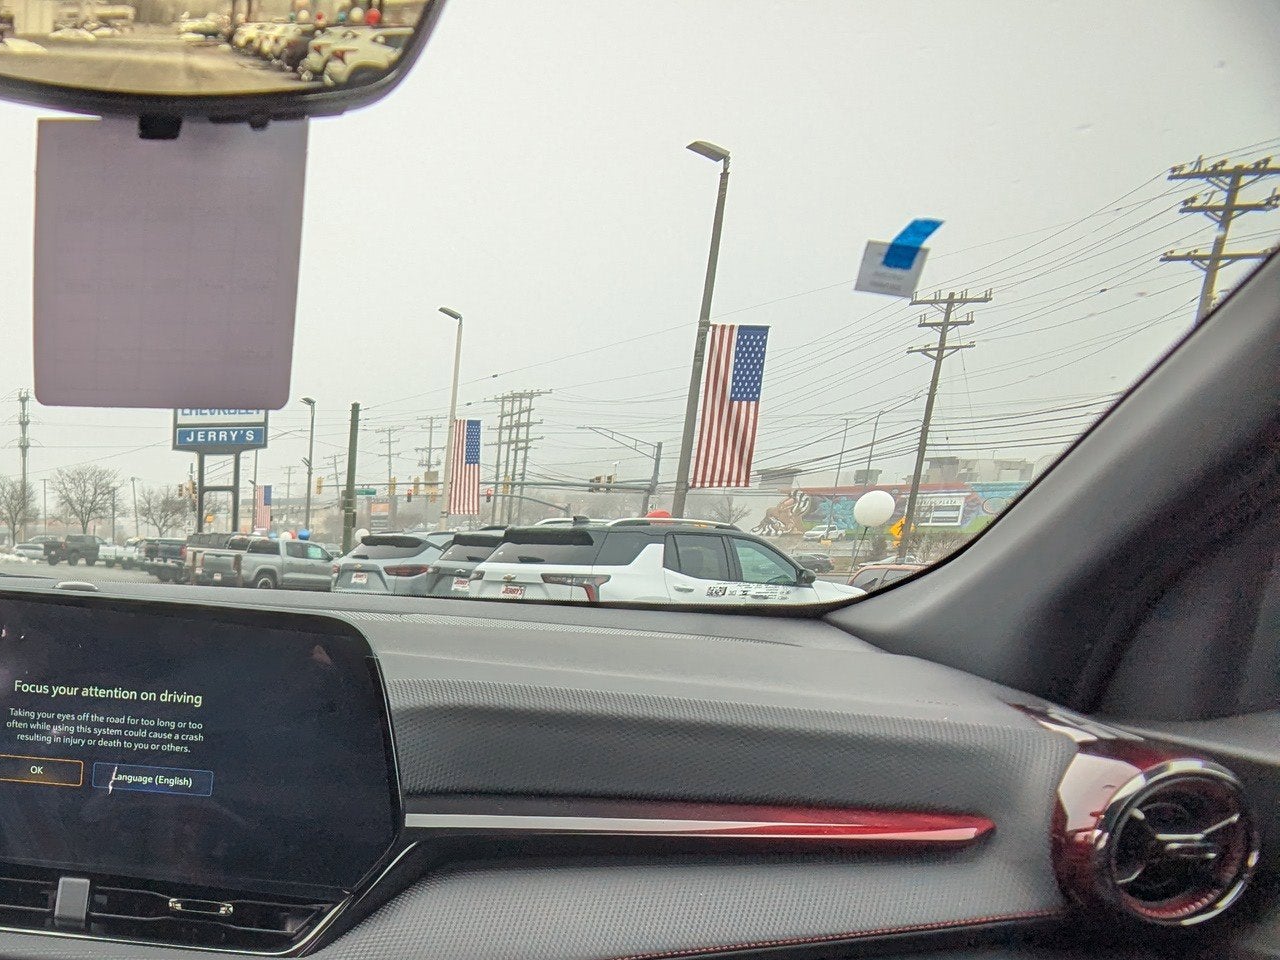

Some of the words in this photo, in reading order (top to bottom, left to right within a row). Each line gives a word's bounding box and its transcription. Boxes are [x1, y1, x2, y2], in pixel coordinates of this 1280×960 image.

[186, 430, 255, 442] JERRY'S
[14, 680, 49, 694] Focus
[51, 685, 79, 697] your
[81, 686, 137, 700] attention
[140, 691, 157, 701] on
[160, 689, 203, 708] driving
[9, 707, 35, 719] Taking
[36, 711, 55, 720] your
[57, 713, 75, 722] eyes
[77, 713, 89, 721] off
[90, 714, 104, 723] the
[106, 715, 125, 724] road
[127, 716, 139, 725] for
[141, 718, 155, 726] too
[157, 718, 176, 730] long
[188, 721, 203, 730] too
[6, 720, 28, 729] often
[29, 722, 51, 731] while
[52, 724, 75, 734] using
[76, 725, 92, 734] this
[93, 727, 122, 737] system
[124, 729, 147, 738] could
[148, 731, 173, 740] cause
[181, 733, 204, 742] crash
[17, 732, 52, 744] resulting
[53, 735, 61, 743] in
[63, 736, 86, 747] injury
[97, 738, 122, 748] death
[123, 740, 132, 748] to
[133, 742, 149, 751] you
[161, 743, 191, 753] others.
[30, 765, 44, 775] OK
[112, 774, 153, 785] Language
[154, 774, 193, 788] (English)
